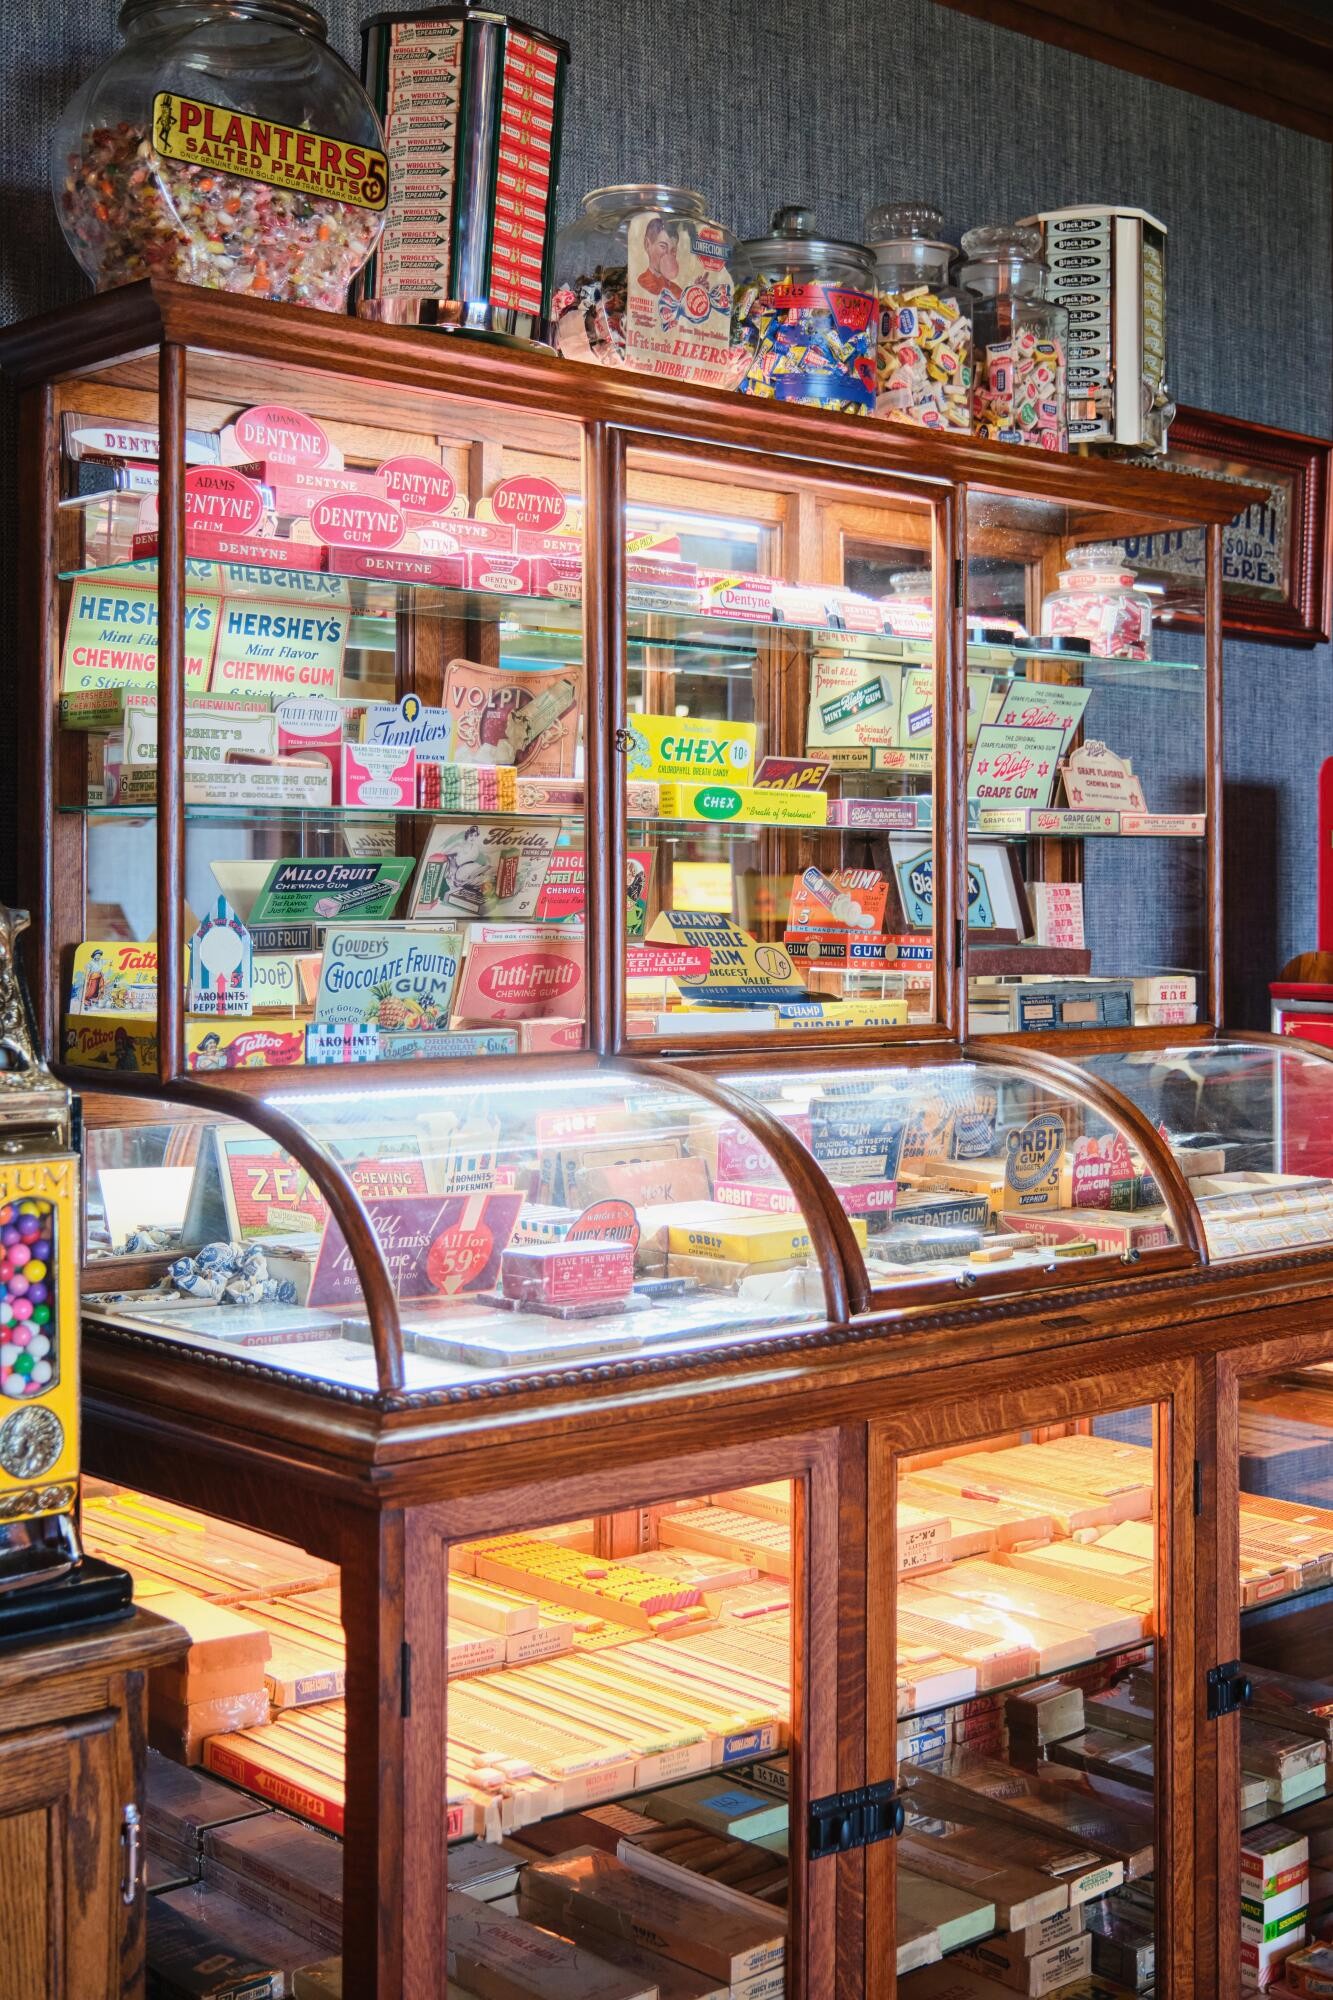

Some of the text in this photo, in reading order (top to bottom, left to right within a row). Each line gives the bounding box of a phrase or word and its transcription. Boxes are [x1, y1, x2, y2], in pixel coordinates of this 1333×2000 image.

[179, 102, 366, 180] PLANTERS
[186, 138, 360, 194] SALTED PEANUTS
[180, 151, 198, 161] ONLY
[201, 157, 231, 169] GENUINE
[234, 166, 254, 174] WHEN
[277, 175, 283, 183] IN
[286, 177, 300, 187] OUR
[302, 182, 323, 193] TRADE
[326, 189, 345, 198] MARK
[405, 191, 442, 199] SPEARMINT
[672, 340, 730, 365] FLEERS
[265, 412, 300, 426] ADAMS
[244, 424, 321, 454] DENTYNE
[268, 451, 296, 465] GUM
[196, 477, 235, 491] ADAMS
[295, 474, 358, 491] DENTYNE
[384, 470, 450, 497] DENTYNE
[185, 493, 254, 519] ENTYNE
[403, 494, 427, 505] GUM
[498, 491, 562, 515] DENTYNE
[193, 520, 223, 532] GUM
[320, 507, 398, 533] DENTYNE
[517, 513, 540, 523] GUM
[344, 531, 371, 542] GUM
[432, 520, 488, 537] DENTYNE
[219, 541, 287, 561] DENTYNE
[1226, 538, 1262, 558] SOLD
[366, 558, 432, 574] DENTYNE
[1223, 557, 1275, 584] ERE
[485, 575, 518, 586] DENTYNE
[725, 592, 771, 608] Dentyne
[79, 595, 212, 630] HERSHY'S
[228, 612, 341, 642] HERSHEY'S
[99, 630, 132, 643] Mint
[73, 647, 155, 671] CHEWING
[246, 644, 318, 660] Mint Flavor
[223, 661, 334, 686] CHEWING GUM
[817, 664, 830, 674] Full
[840, 667, 857, 676] REAL
[452, 686, 521, 708] VOLPI
[193, 700, 242, 712] CHEWING
[824, 692, 881, 723] MINT GUM
[374, 720, 449, 746] Tempters
[855, 724, 891, 735] Deliciously
[660, 737, 730, 764] CHEX
[693, 767, 710, 776] BREATH
[712, 767, 729, 777] CANDY
[992, 751, 1034, 781] Blatz
[1097, 769, 1124, 778] FLAVORED
[251, 774, 328, 786] CHEWING GUM
[977, 785, 1038, 799] GRAPE GUM
[703, 796, 736, 809] CHEX
[875, 811, 912, 820] GRAPE GUM
[483, 828, 548, 847] Florida
[279, 865, 376, 882] MILO FRUIT
[842, 870, 880, 890] GUM!
[672, 912, 723, 928] CHAMP
[278, 931, 309, 946] FRUIT
[332, 935, 389, 958] GOUDEY'S
[684, 931, 747, 947] BUBBLE
[711, 949, 746, 965] GUM
[789, 945, 806, 956] GUM
[854, 945, 882, 956] GUM
[655, 957, 701, 966] LAUREL
[325, 947, 456, 993] CHOCOLATE FRUITED
[490, 963, 574, 989] Tutti-Frutti
[710, 968, 748, 977] BIGGEST
[396, 977, 447, 993] GUM
[741, 976, 772, 985] VALUE
[197, 992, 245, 1001] AROMINTS
[496, 988, 558, 997] CHEWING GUM
[700, 986, 792, 994] FINEST INGREDIENTS
[193, 1003, 248, 1011] PEPPERMINT
[787, 1005, 820, 1017] CHAMP
[235, 1033, 282, 1055] Tattoo
[318, 1035, 377, 1047] AROMINTS
[839, 1122, 871, 1136] GUM
[854, 1137, 893, 1145] ANTISEPTIC
[1008, 1127, 1064, 1153] ORBIT
[827, 1144, 877, 1157] NUGGETS
[1021, 1151, 1045, 1163] GUM
[352, 1172, 413, 1184] CHEWING
[1076, 1163, 1111, 1179] ORBIT
[1094, 1179, 1109, 1189] GUM
[717, 1190, 795, 1211] ORBIT GUM
[867, 1190, 894, 1206] GUM
[962, 1205, 985, 1222] GUM
[399, 1230, 431, 1248] miss
[605, 1225, 633, 1239] FRUIT
[438, 1233, 488, 1248] All for
[689, 1235, 722, 1248] ORBIT
[440, 1249, 481, 1274] 59¢
[556, 1256, 577, 1266] SAVE
[580, 1255, 594, 1264] THE
[262, 1777, 325, 1816] SPEARMINT
